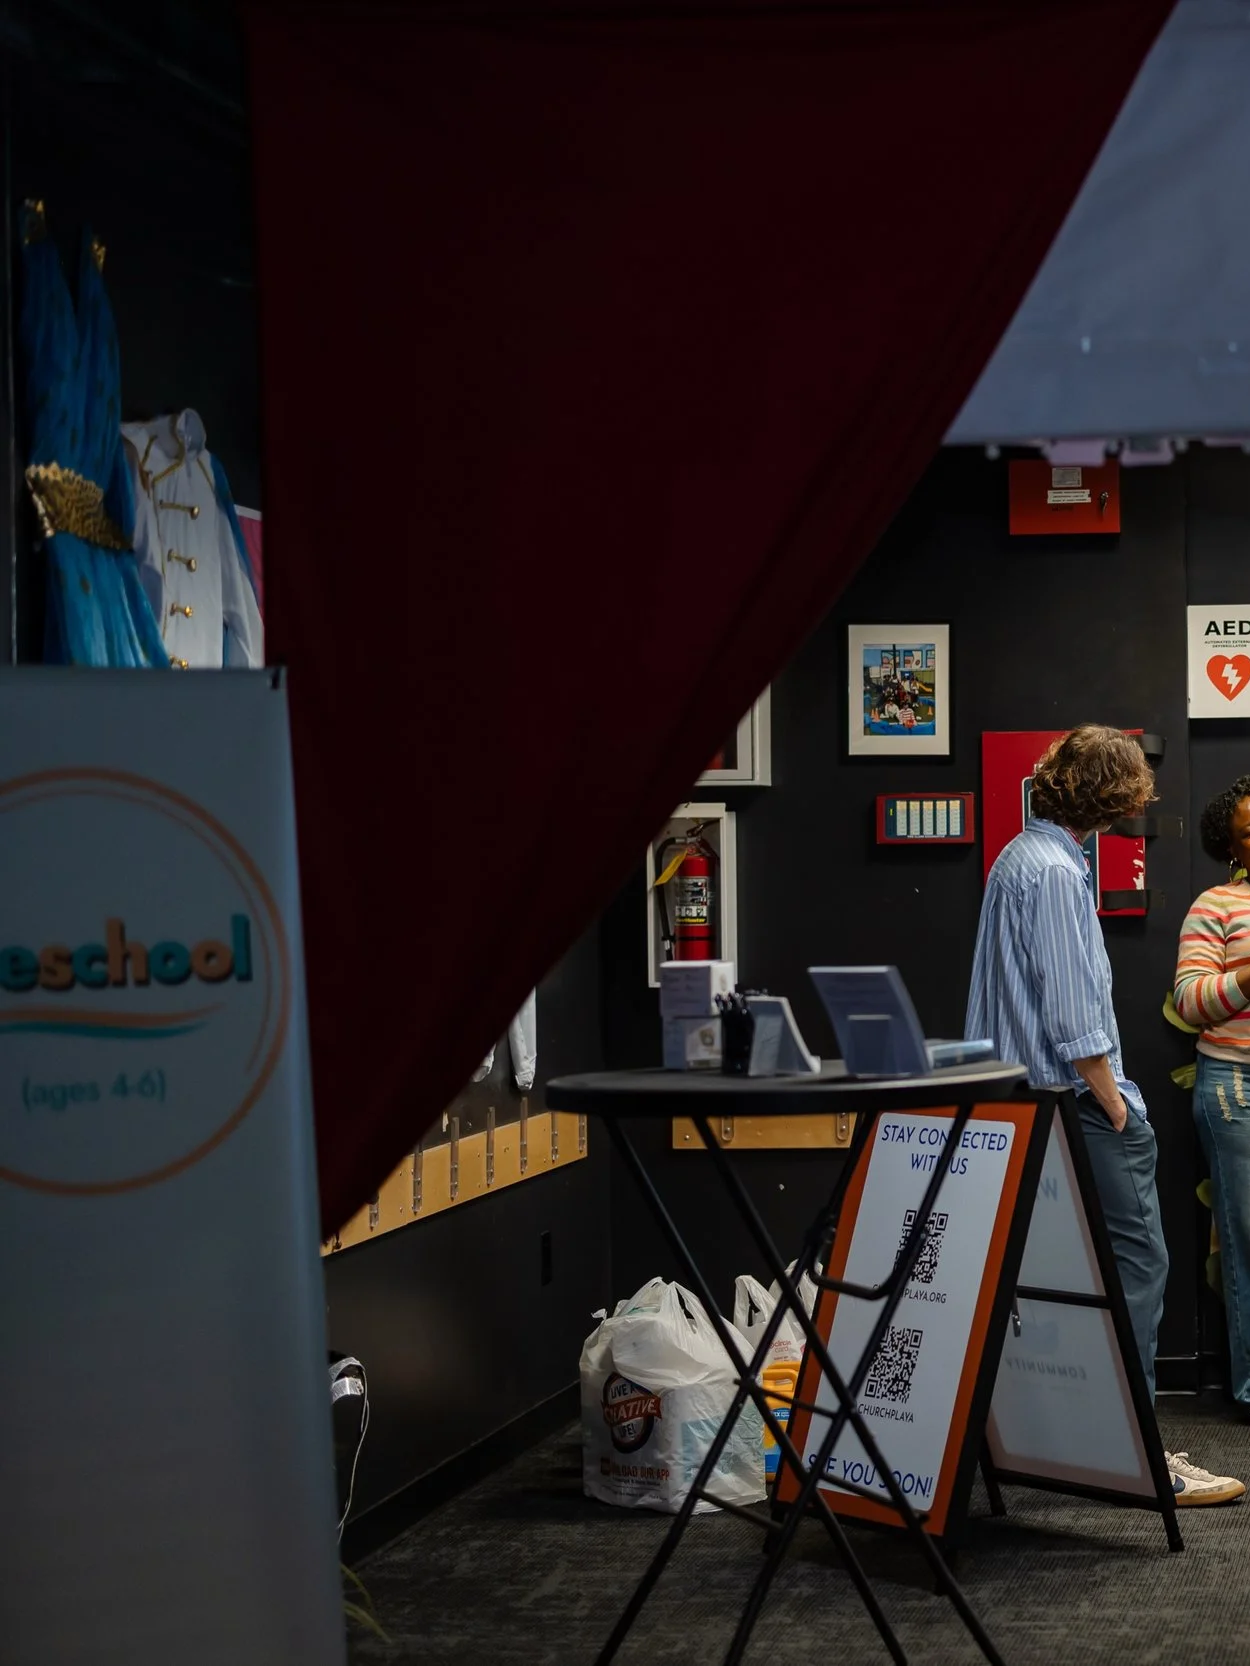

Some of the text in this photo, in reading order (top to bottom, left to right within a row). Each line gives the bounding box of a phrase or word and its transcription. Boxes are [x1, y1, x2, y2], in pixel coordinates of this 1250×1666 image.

[21, 1077, 101, 1113] (ages
[881, 1124, 1008, 1151] STAY CONECTED
[949, 1157, 969, 1175] US
[857, 1403, 915, 1423] CHURCHPLAYA
[808, 1454, 838, 1475] SE
[842, 1460, 877, 1486] YOU
